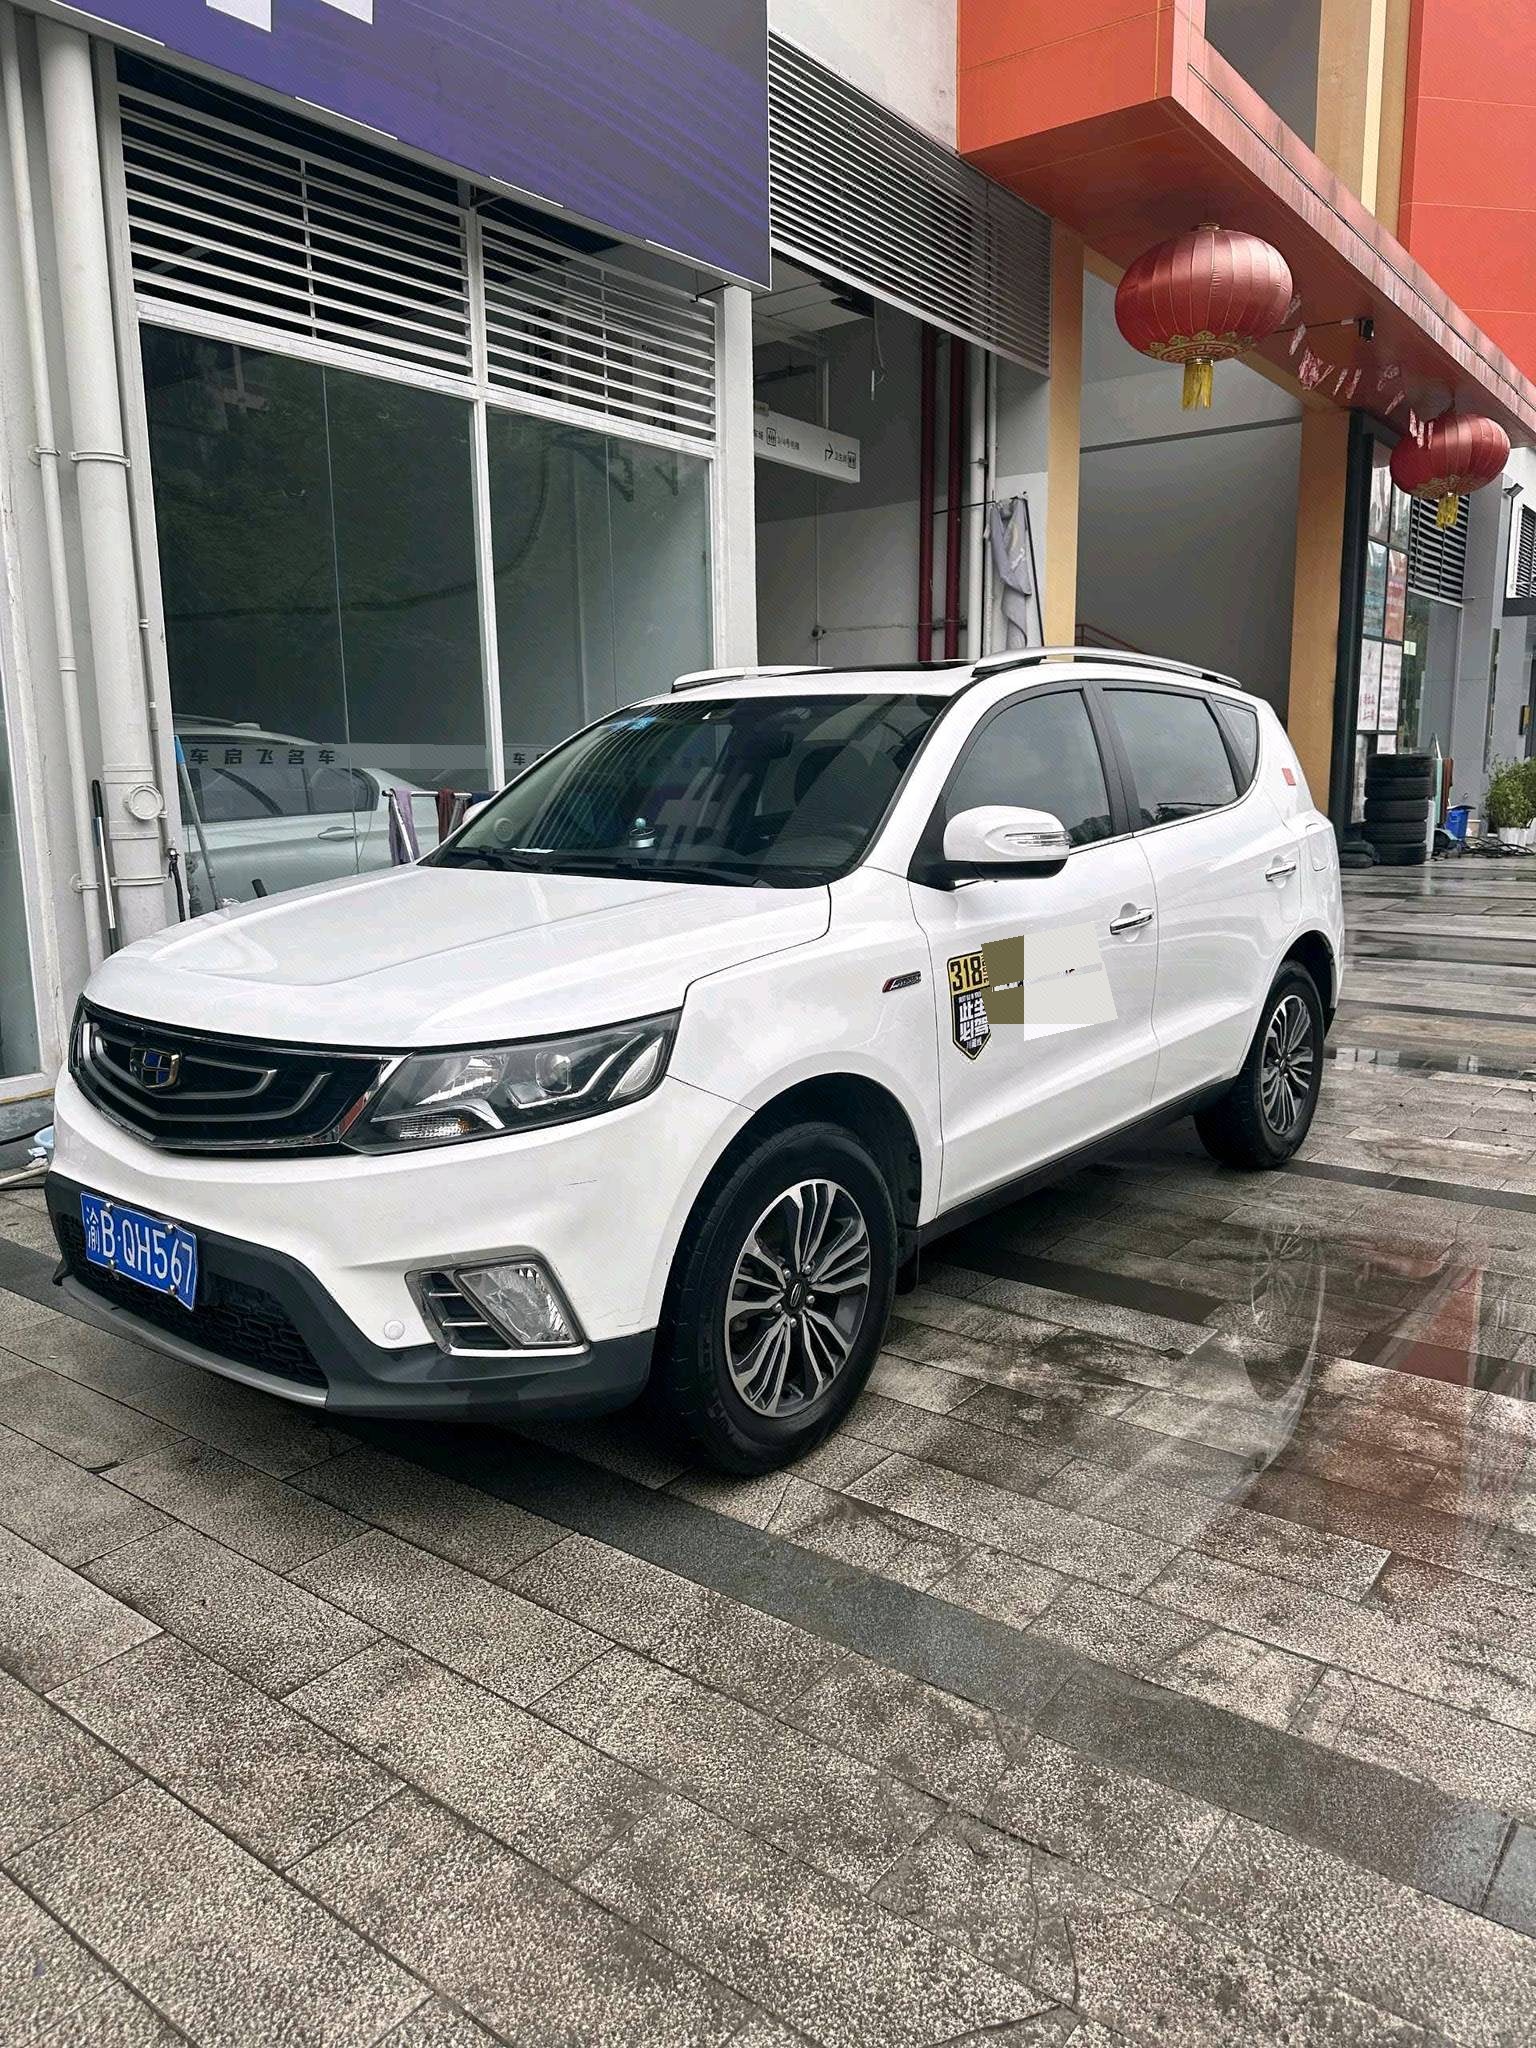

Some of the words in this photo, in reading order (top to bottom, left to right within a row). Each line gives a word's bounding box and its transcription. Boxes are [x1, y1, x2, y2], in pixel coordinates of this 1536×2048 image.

[190, 748, 336, 765] 车启飞名车
[950, 956, 983, 992] 318
[960, 998, 987, 1022] 此生
[960, 1017, 990, 1042] 必驾
